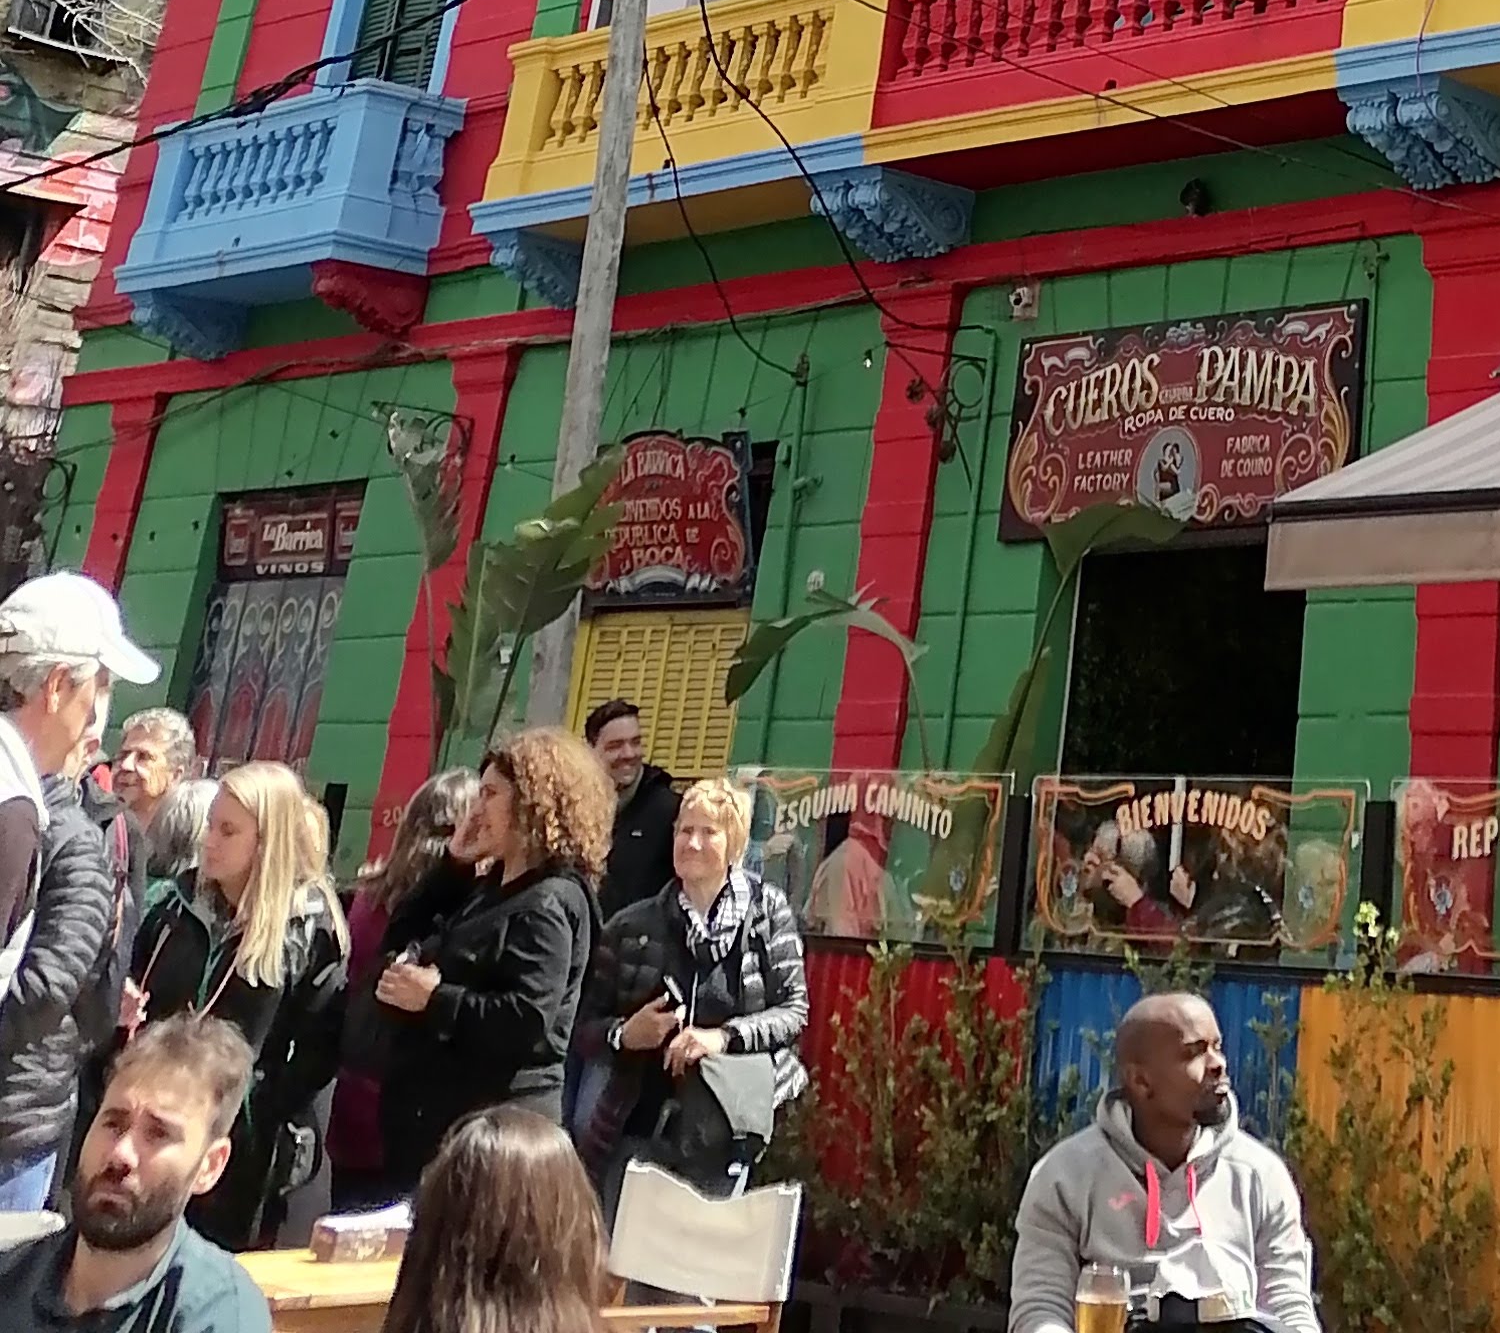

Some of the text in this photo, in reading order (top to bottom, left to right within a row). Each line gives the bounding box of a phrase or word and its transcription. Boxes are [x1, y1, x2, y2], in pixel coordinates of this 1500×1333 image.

[1043, 345, 1319, 437] CUEROS PAMPA
[1124, 404, 1236, 433] ROPA DE CUERO
[1226, 434, 1271, 453] FABRICA
[1078, 447, 1133, 470] LEATHER
[1220, 457, 1273, 479] DE COURO
[1073, 472, 1130, 494] FACTORY
[272, 521, 323, 552] Barrica
[255, 562, 325, 575] VINOS
[632, 546, 687, 572] BOCA
[773, 780, 952, 840] ESQUINA CAMINITO
[1116, 789, 1271, 841] BIENVENIDOS
